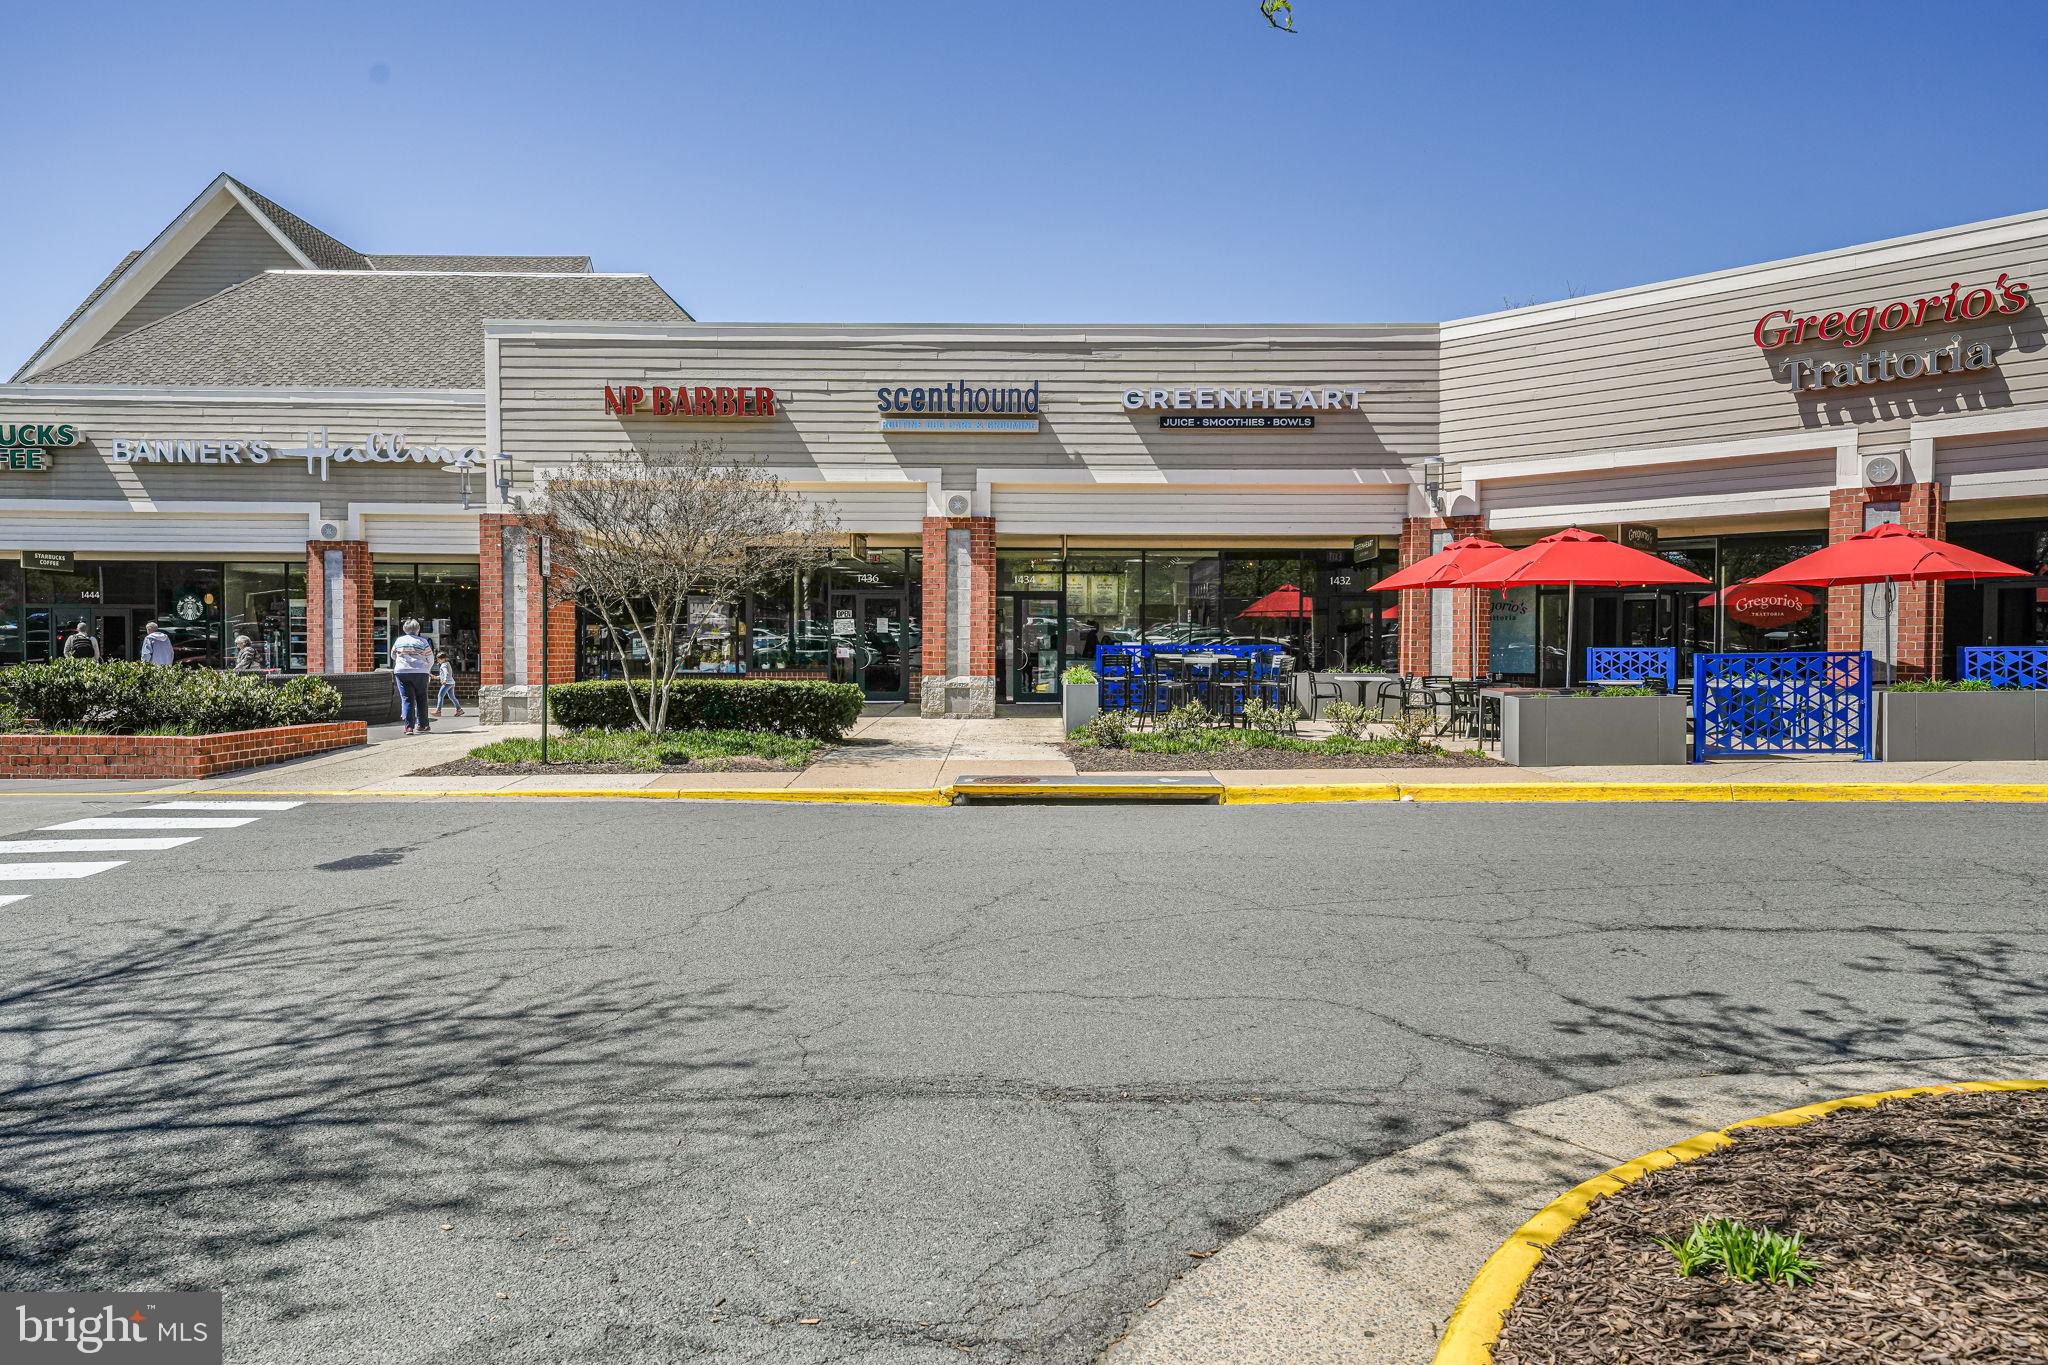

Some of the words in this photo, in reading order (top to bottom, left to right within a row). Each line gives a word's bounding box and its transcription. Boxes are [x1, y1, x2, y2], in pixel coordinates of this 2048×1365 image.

[1753, 272, 2030, 349] Gregorio's
[1779, 334, 1996, 393] Trattoria
[604, 385, 644, 415] NP
[652, 386, 776, 417] BARBER
[877, 379, 1039, 413] scenthound
[1121, 387, 1367, 410] GREENHEART
[1163, 418, 1195, 427] JUICE
[1202, 418, 1265, 427] SMOOTHIES
[1273, 418, 1312, 427] BOWLS
[112, 438, 270, 464] BANNER'S
[34, 553, 66, 561] STARBUCKS
[39, 559, 60, 567] COFFEE
[857, 573, 880, 583] 1436
[1014, 575, 1036, 584] 1434
[1329, 576, 1352, 585] 1432
[81, 591, 100, 599] 1444
[1736, 593, 1803, 612] Gregorio's
[837, 610, 852, 618] OPEN
